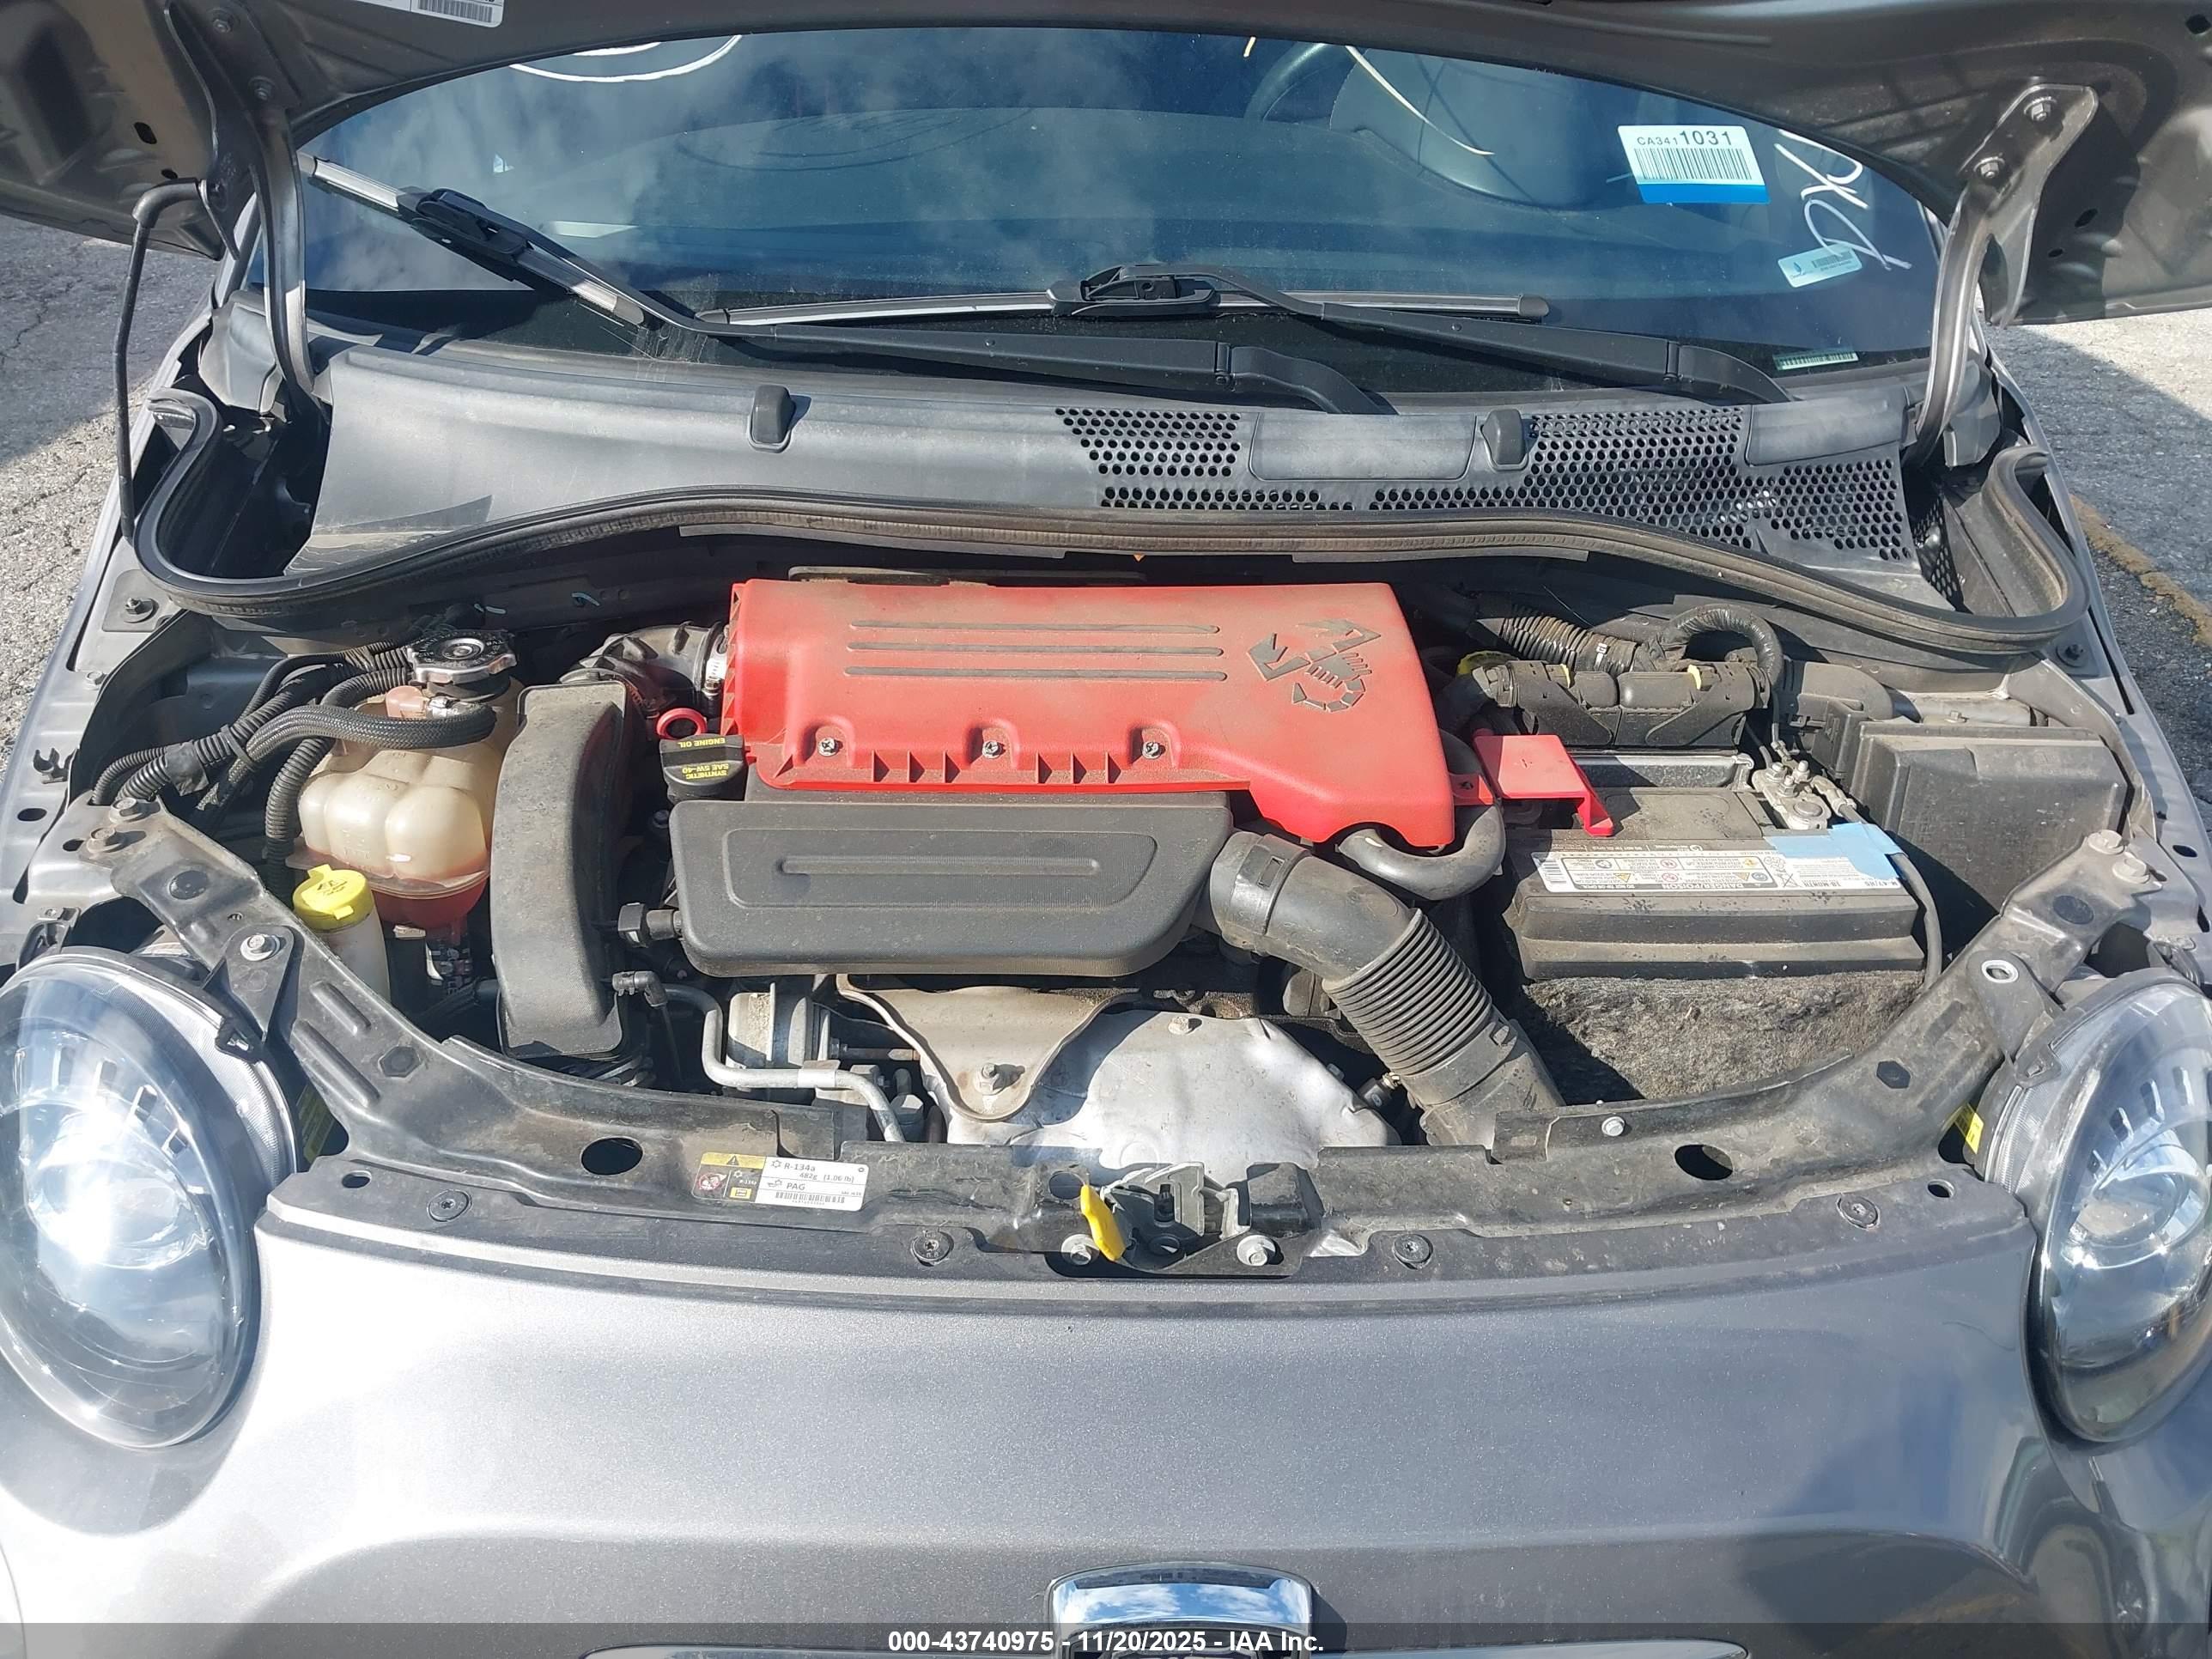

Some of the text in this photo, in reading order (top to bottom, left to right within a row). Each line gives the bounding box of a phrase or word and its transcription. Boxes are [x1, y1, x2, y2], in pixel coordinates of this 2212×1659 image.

[693, 737, 726, 747] ENGINE
[682, 764, 711, 775] 5W-40
[685, 769, 727, 780] SYNTHETIC
[783, 1162, 816, 1171] R-134a
[799, 1172, 818, 1181] 482g
[786, 1182, 806, 1191] PAG
